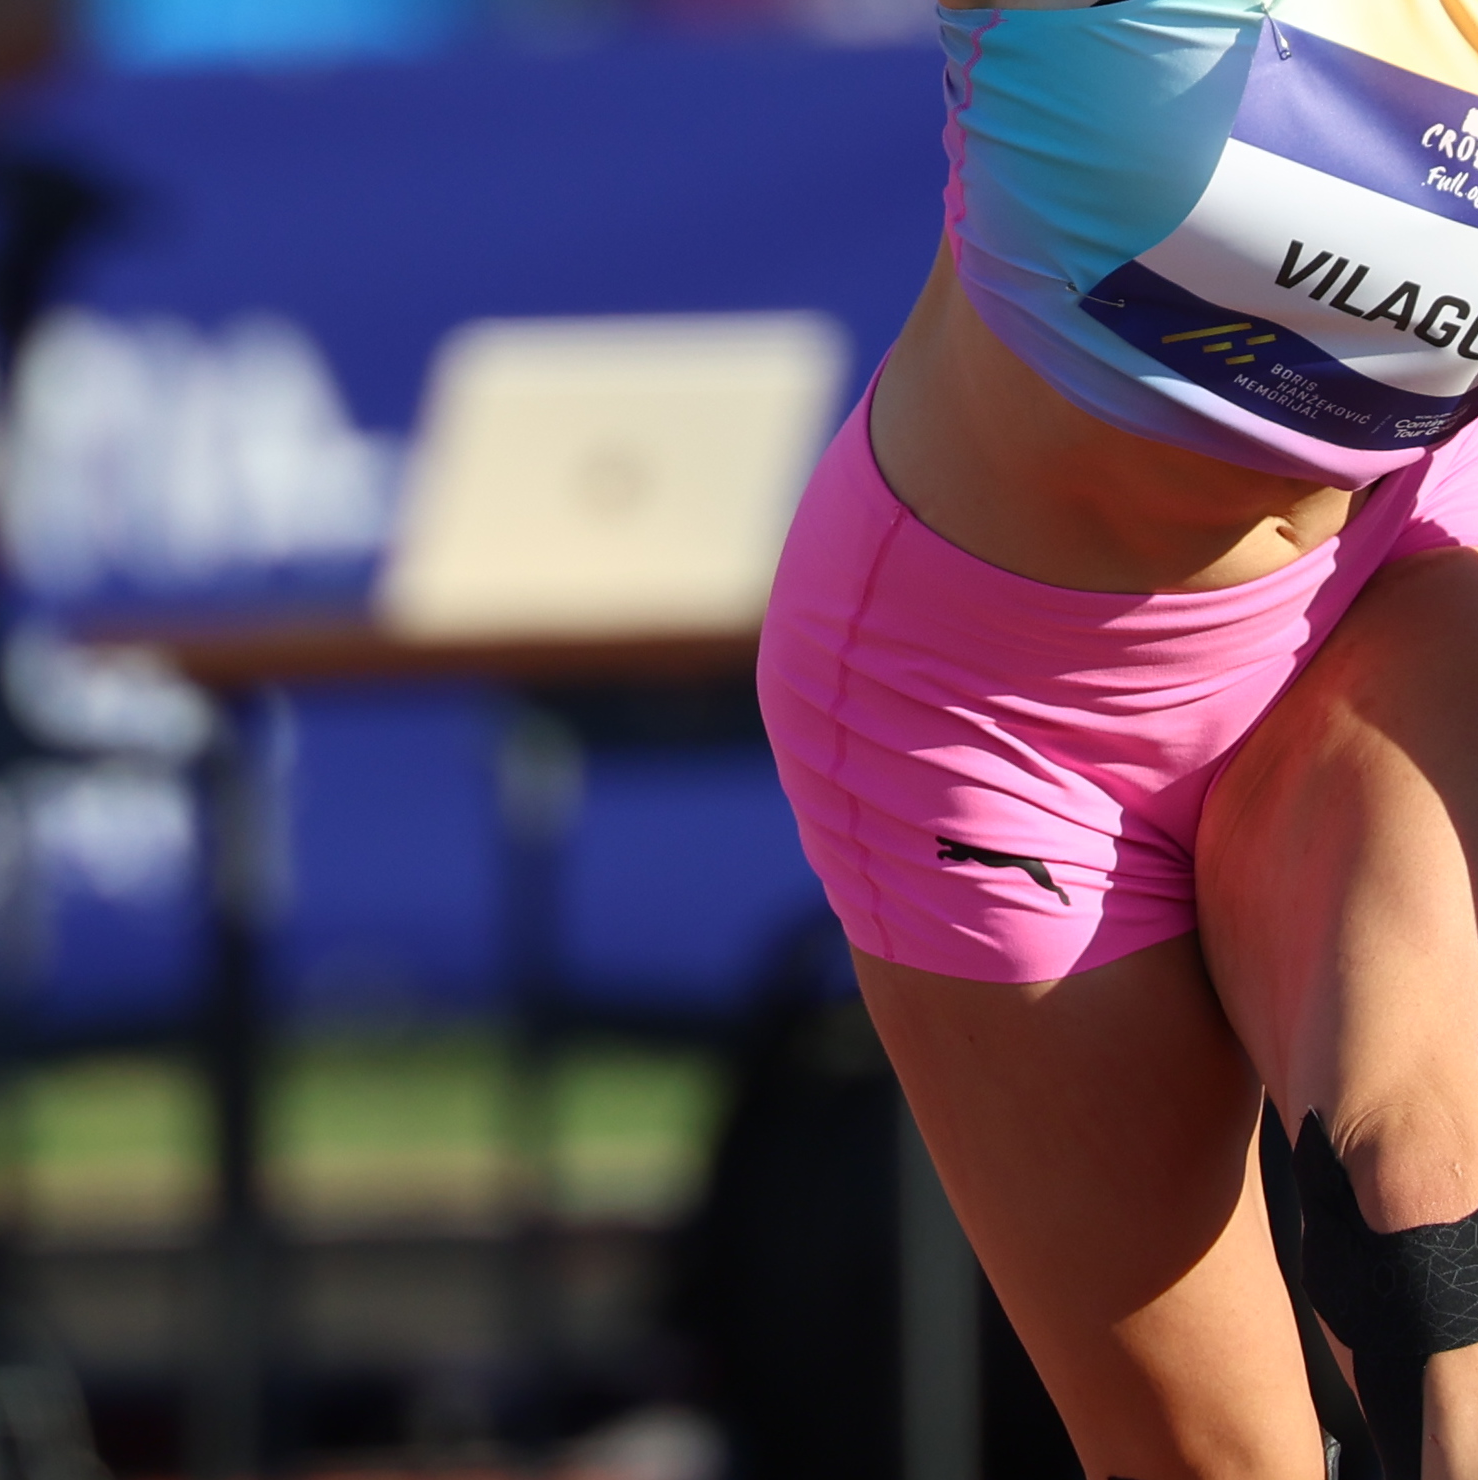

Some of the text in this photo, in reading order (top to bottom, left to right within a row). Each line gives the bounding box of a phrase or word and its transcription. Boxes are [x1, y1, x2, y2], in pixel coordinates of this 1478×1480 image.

[1427, 166, 1469, 197] Full
[1270, 363, 1318, 391] BORIS
[1233, 373, 1318, 420] MEMORIJAL
[1276, 381, 1373, 424] HANŽEKOVIĆ
[1394, 428, 1425, 438] Tour
